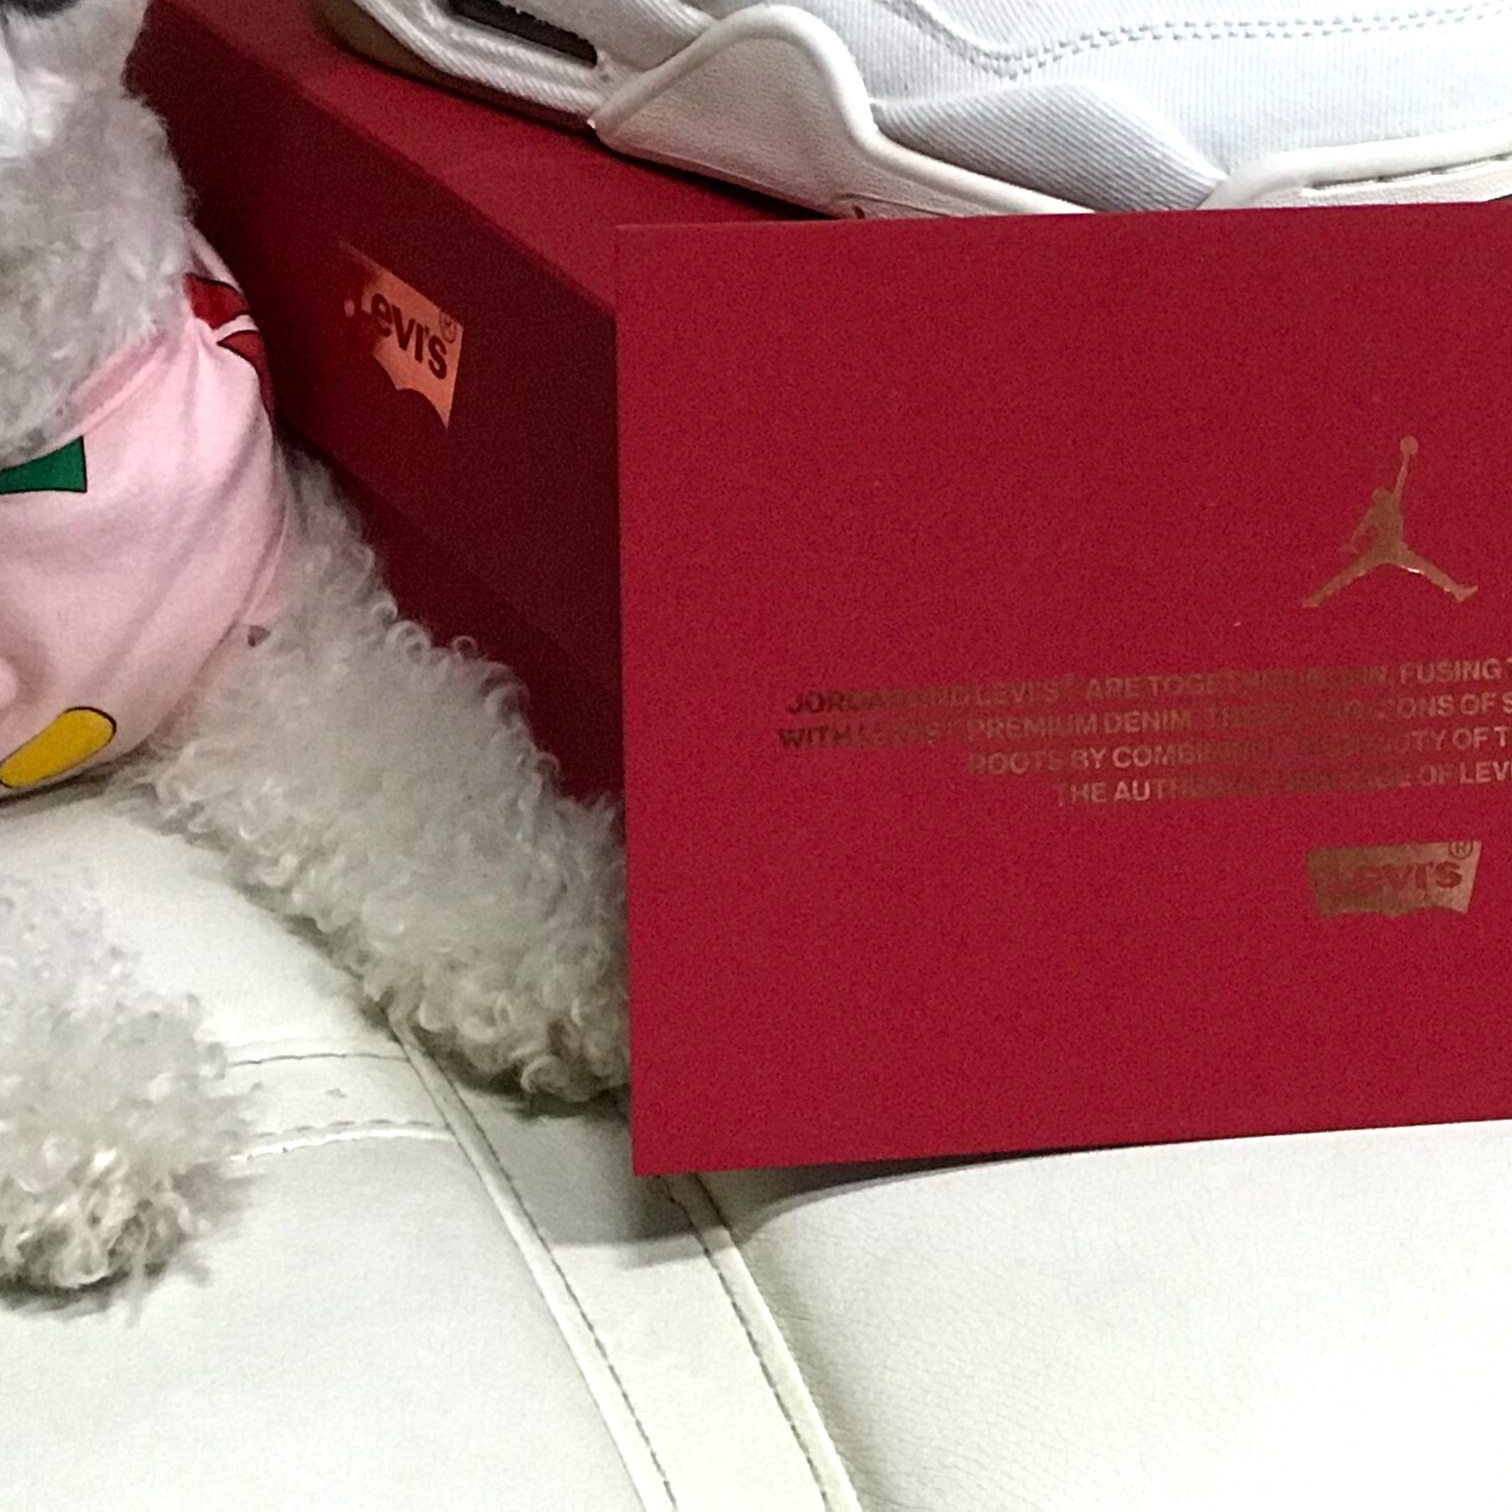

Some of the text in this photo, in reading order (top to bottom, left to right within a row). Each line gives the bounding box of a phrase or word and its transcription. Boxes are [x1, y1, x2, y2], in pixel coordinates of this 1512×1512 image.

[1085, 675, 1142, 700] ARE
[1400, 658, 1501, 684] FUSING
[966, 711, 1098, 742] PREMIUM
[1460, 693, 1498, 716] OF
[968, 748, 1064, 776] ROOTS
[1071, 747, 1107, 770] BY
[1452, 726, 1488, 750] OF
[1058, 781, 1108, 807] THE
[1418, 763, 1455, 786] OF
